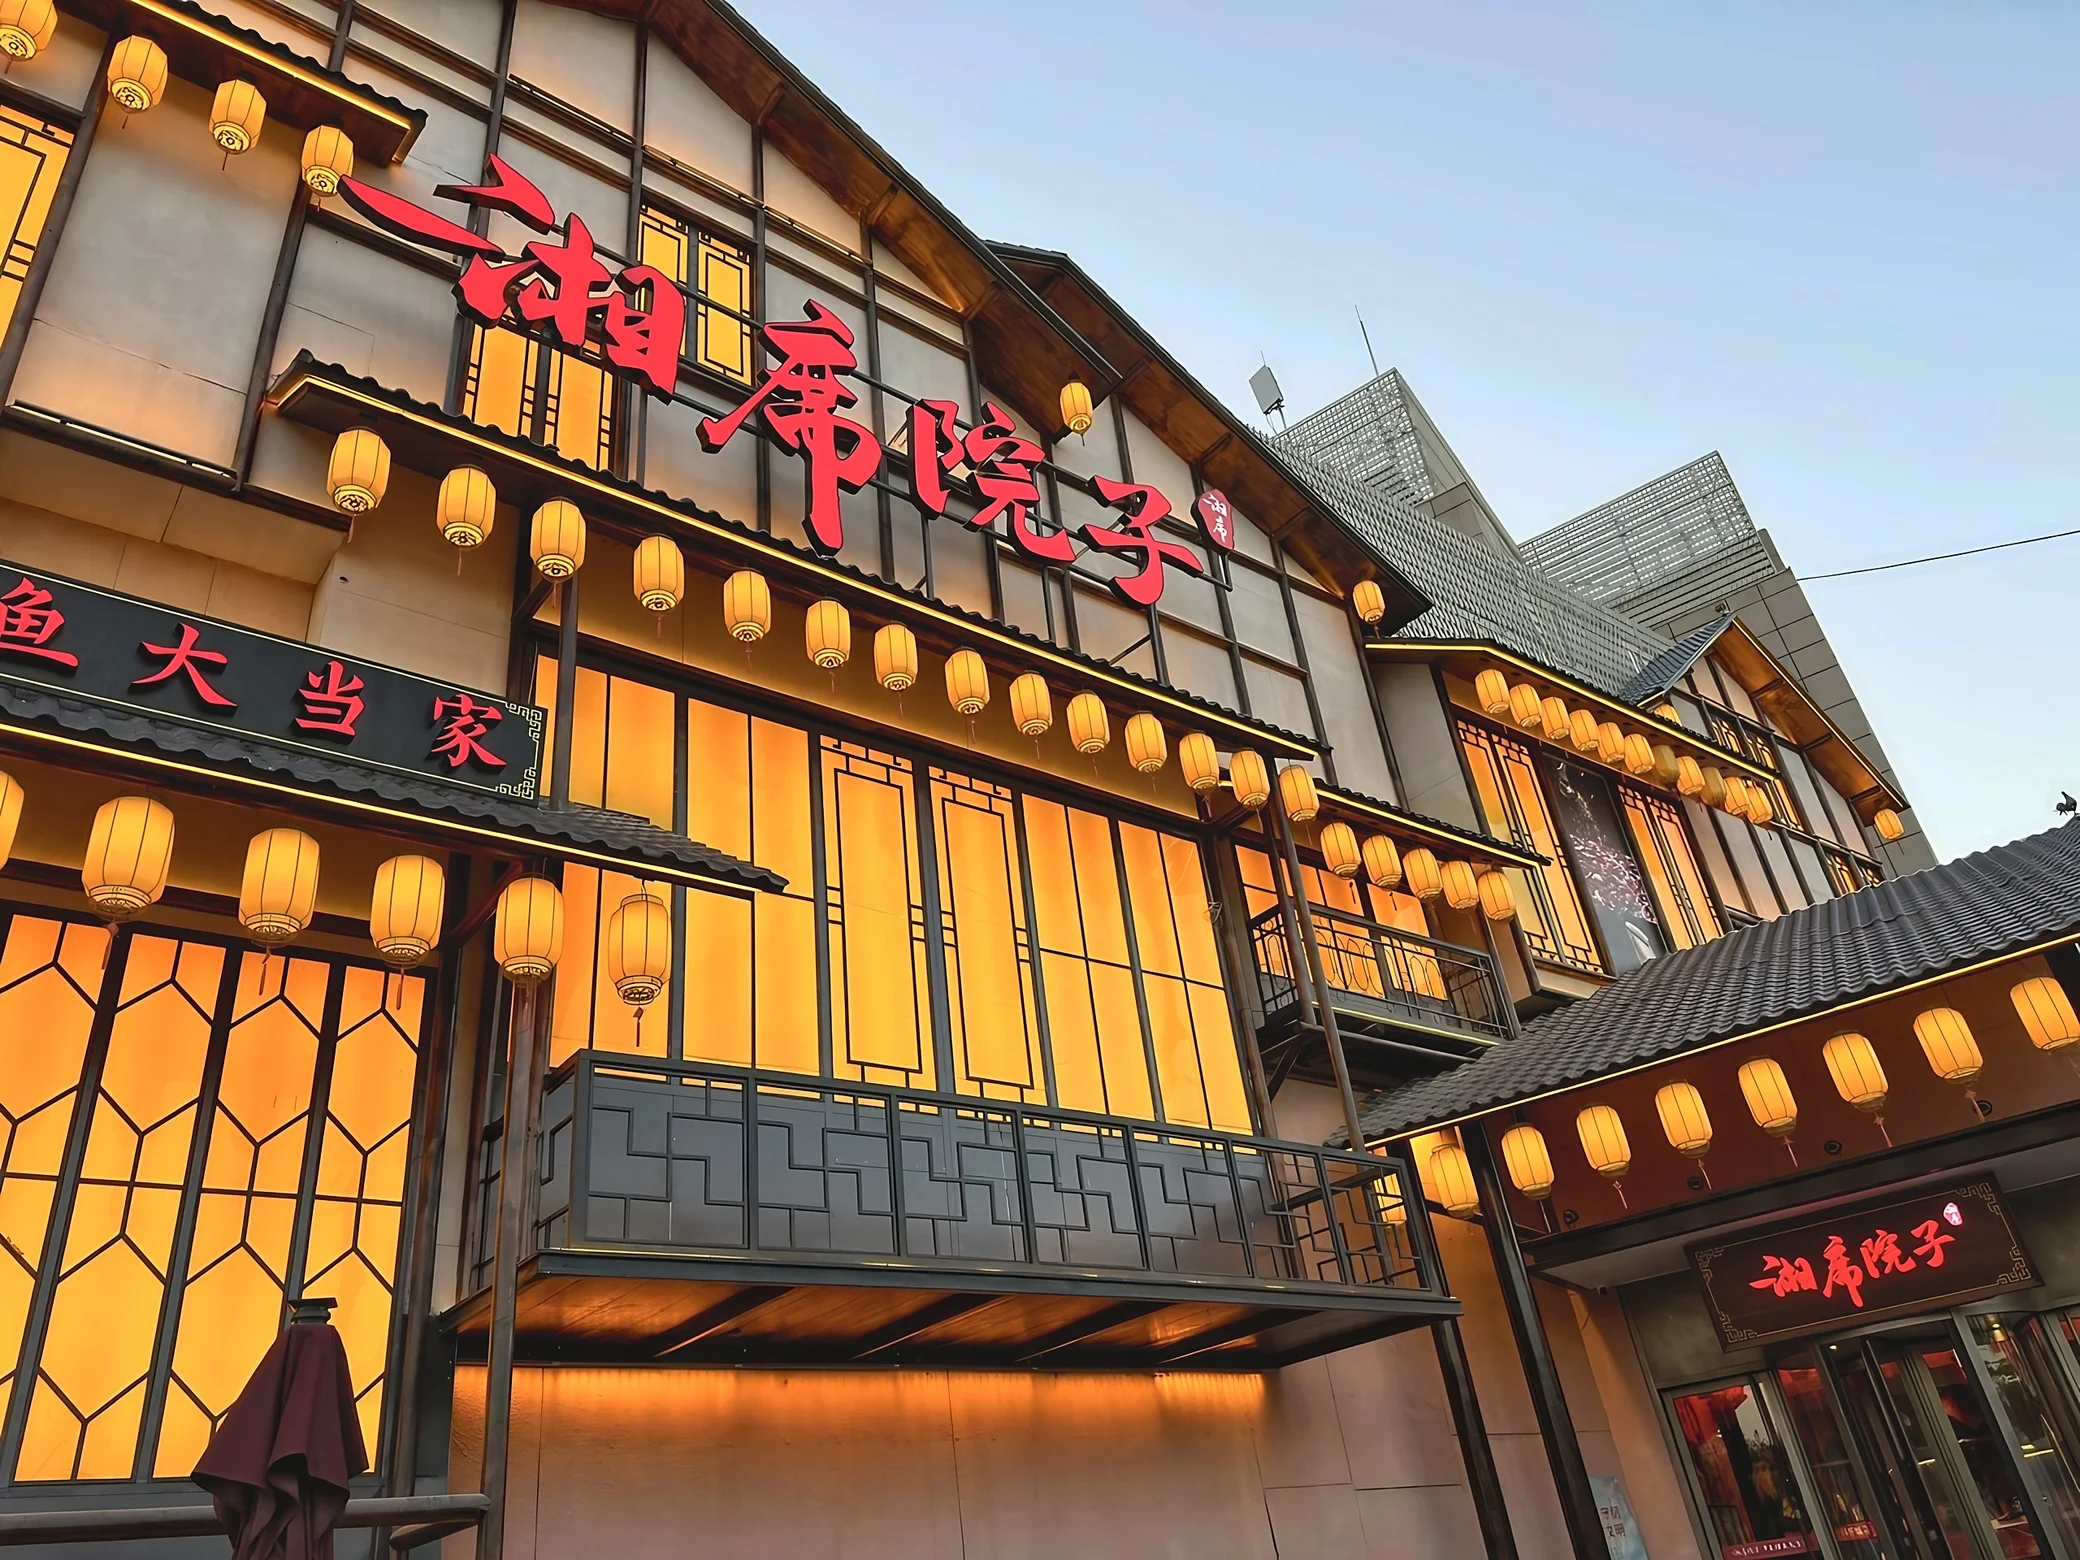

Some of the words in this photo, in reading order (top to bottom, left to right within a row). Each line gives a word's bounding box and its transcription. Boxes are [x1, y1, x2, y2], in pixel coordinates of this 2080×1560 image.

[337, 152, 1203, 607] 湘席院子
[0, 577, 507, 768] 鱼大当家
[1749, 1219, 1956, 1307] 湘席院子
